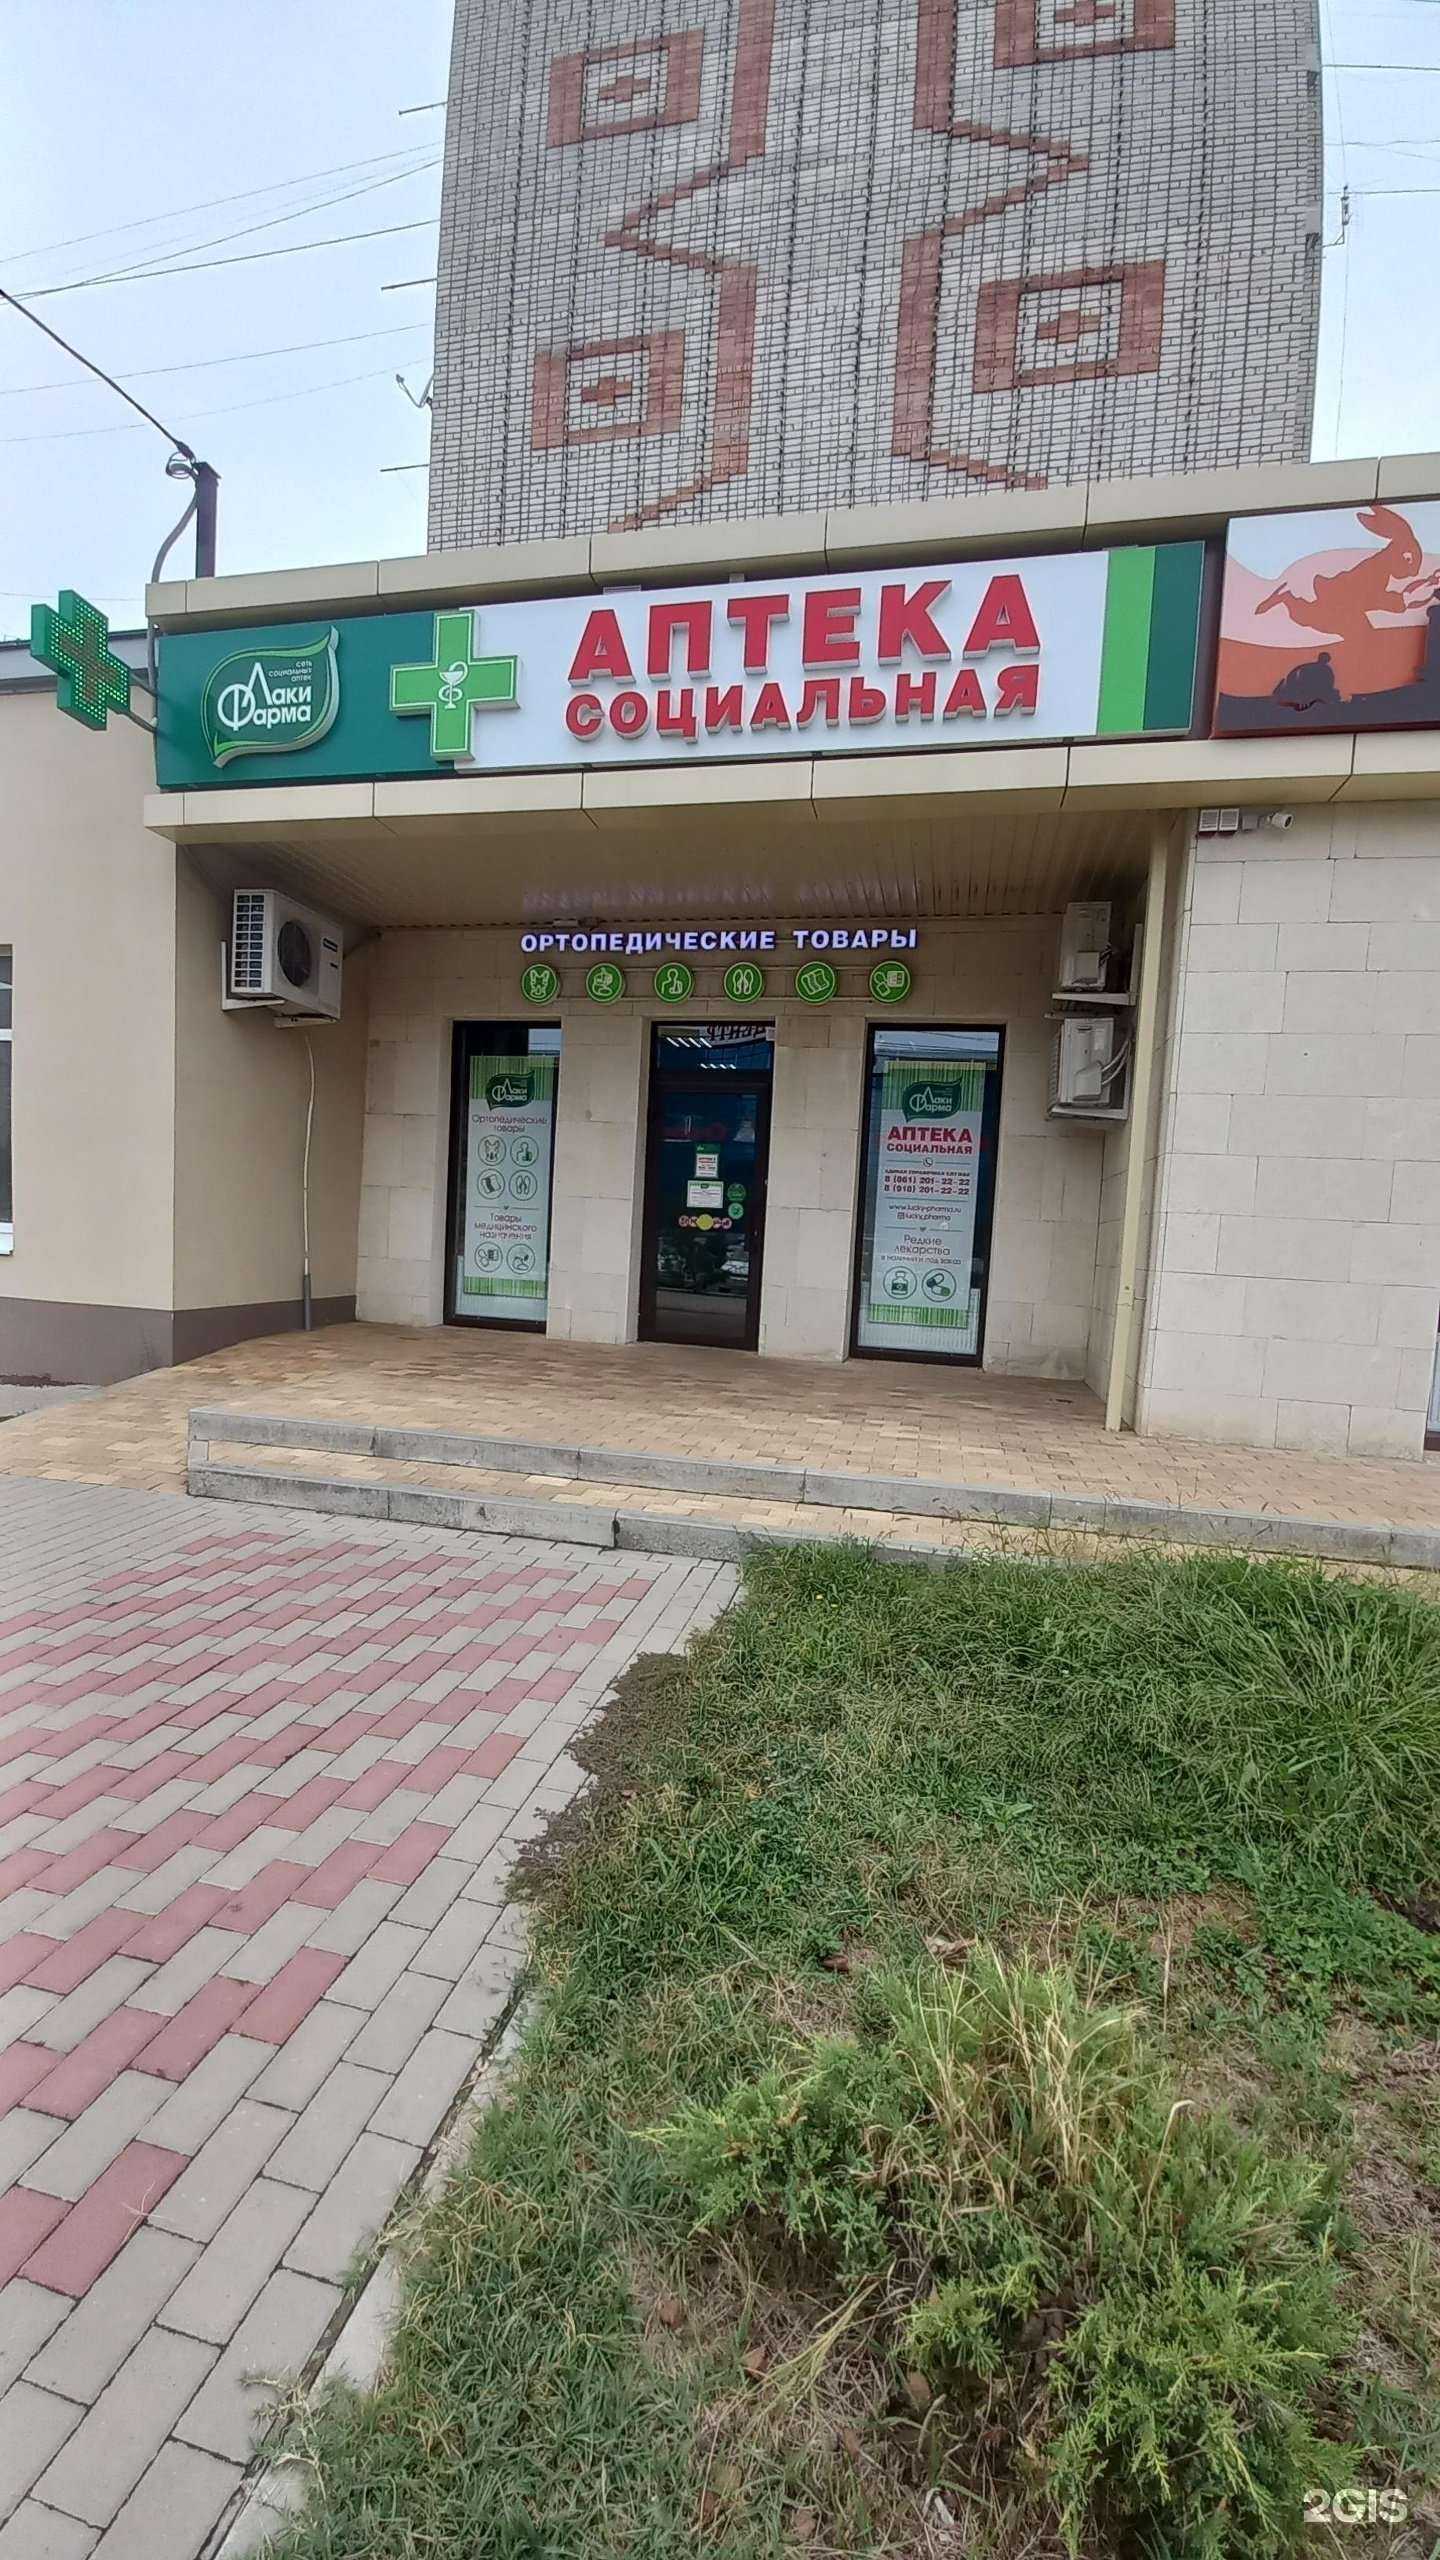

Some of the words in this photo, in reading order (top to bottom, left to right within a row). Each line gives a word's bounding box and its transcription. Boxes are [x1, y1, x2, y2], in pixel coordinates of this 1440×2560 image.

[568, 574, 1040, 686] АПТЕКА
[217, 683, 312, 732] Фарма
[565, 664, 1040, 743] СОЦИАЛЬНАЯ
[520, 930, 776, 954] ОРТОПЕДИЧЕСКИЕ
[793, 928, 917, 950] ТОВАРЫ
[888, 1126, 972, 1143] АПТЕКА
[886, 1143, 972, 1154] СОЦИАЛЬНАЯ
[894, 1245, 951, 1256] лекарства
[904, 1234, 942, 1246] Редкие
